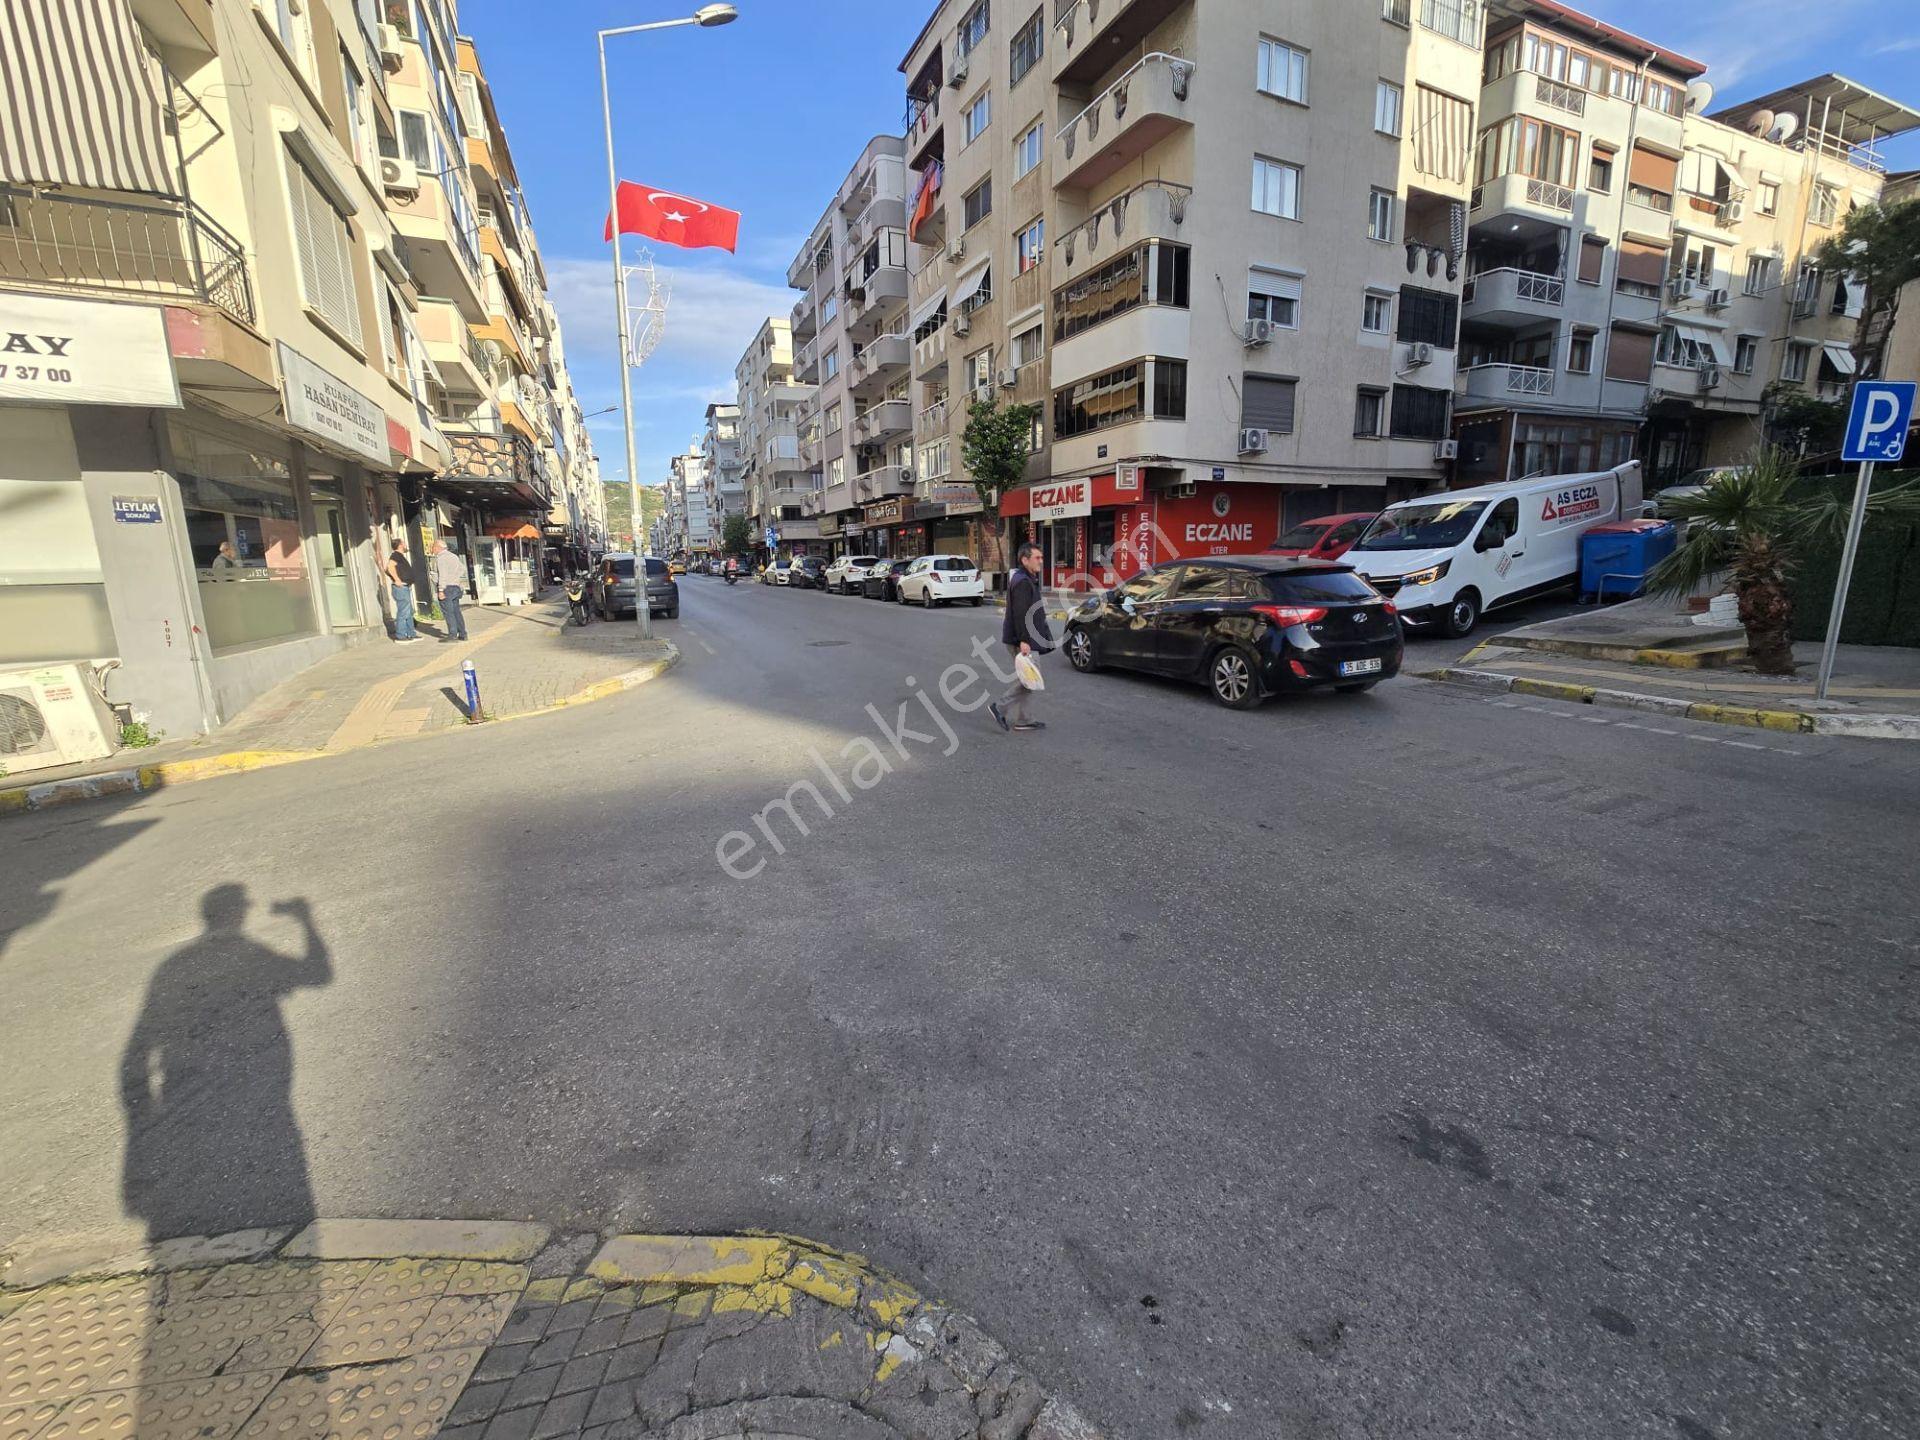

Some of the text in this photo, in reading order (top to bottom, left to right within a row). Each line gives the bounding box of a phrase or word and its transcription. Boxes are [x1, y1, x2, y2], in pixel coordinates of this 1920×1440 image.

[0, 332, 74, 357] AY
[15, 365, 39, 380] 37
[46, 368, 72, 382] 00
[303, 383, 338, 414] HASAN
[1857, 391, 1899, 452] P
[115, 501, 157, 512] LEYLAK
[1033, 484, 1084, 508] ECZANE
[1557, 486, 1598, 505] AS ECZA
[1121, 513, 1129, 570] ECZANE
[1140, 512, 1149, 570] ECZANE
[1185, 523, 1253, 541] ECZANE
